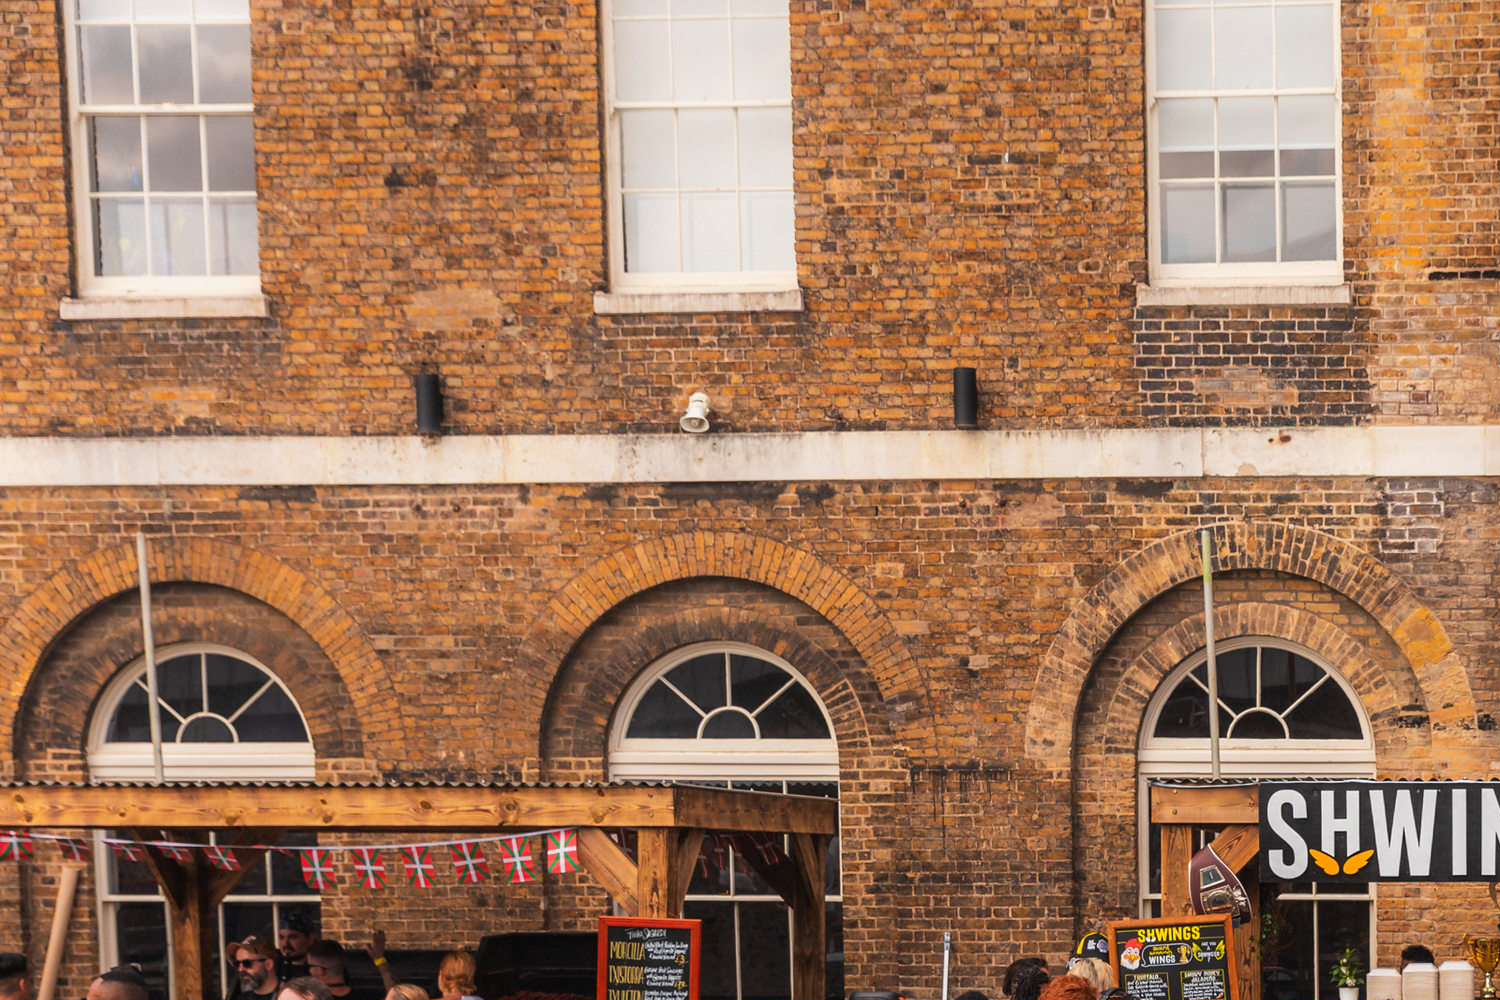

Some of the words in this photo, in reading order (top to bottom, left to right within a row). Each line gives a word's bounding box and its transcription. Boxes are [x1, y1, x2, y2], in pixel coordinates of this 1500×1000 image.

[1137, 926, 1200, 943] SHWINGS
[610, 941, 645, 960] MORCILLA
[1149, 955, 1175, 964] WINGS
[609, 965, 644, 985] TXISTORRA
